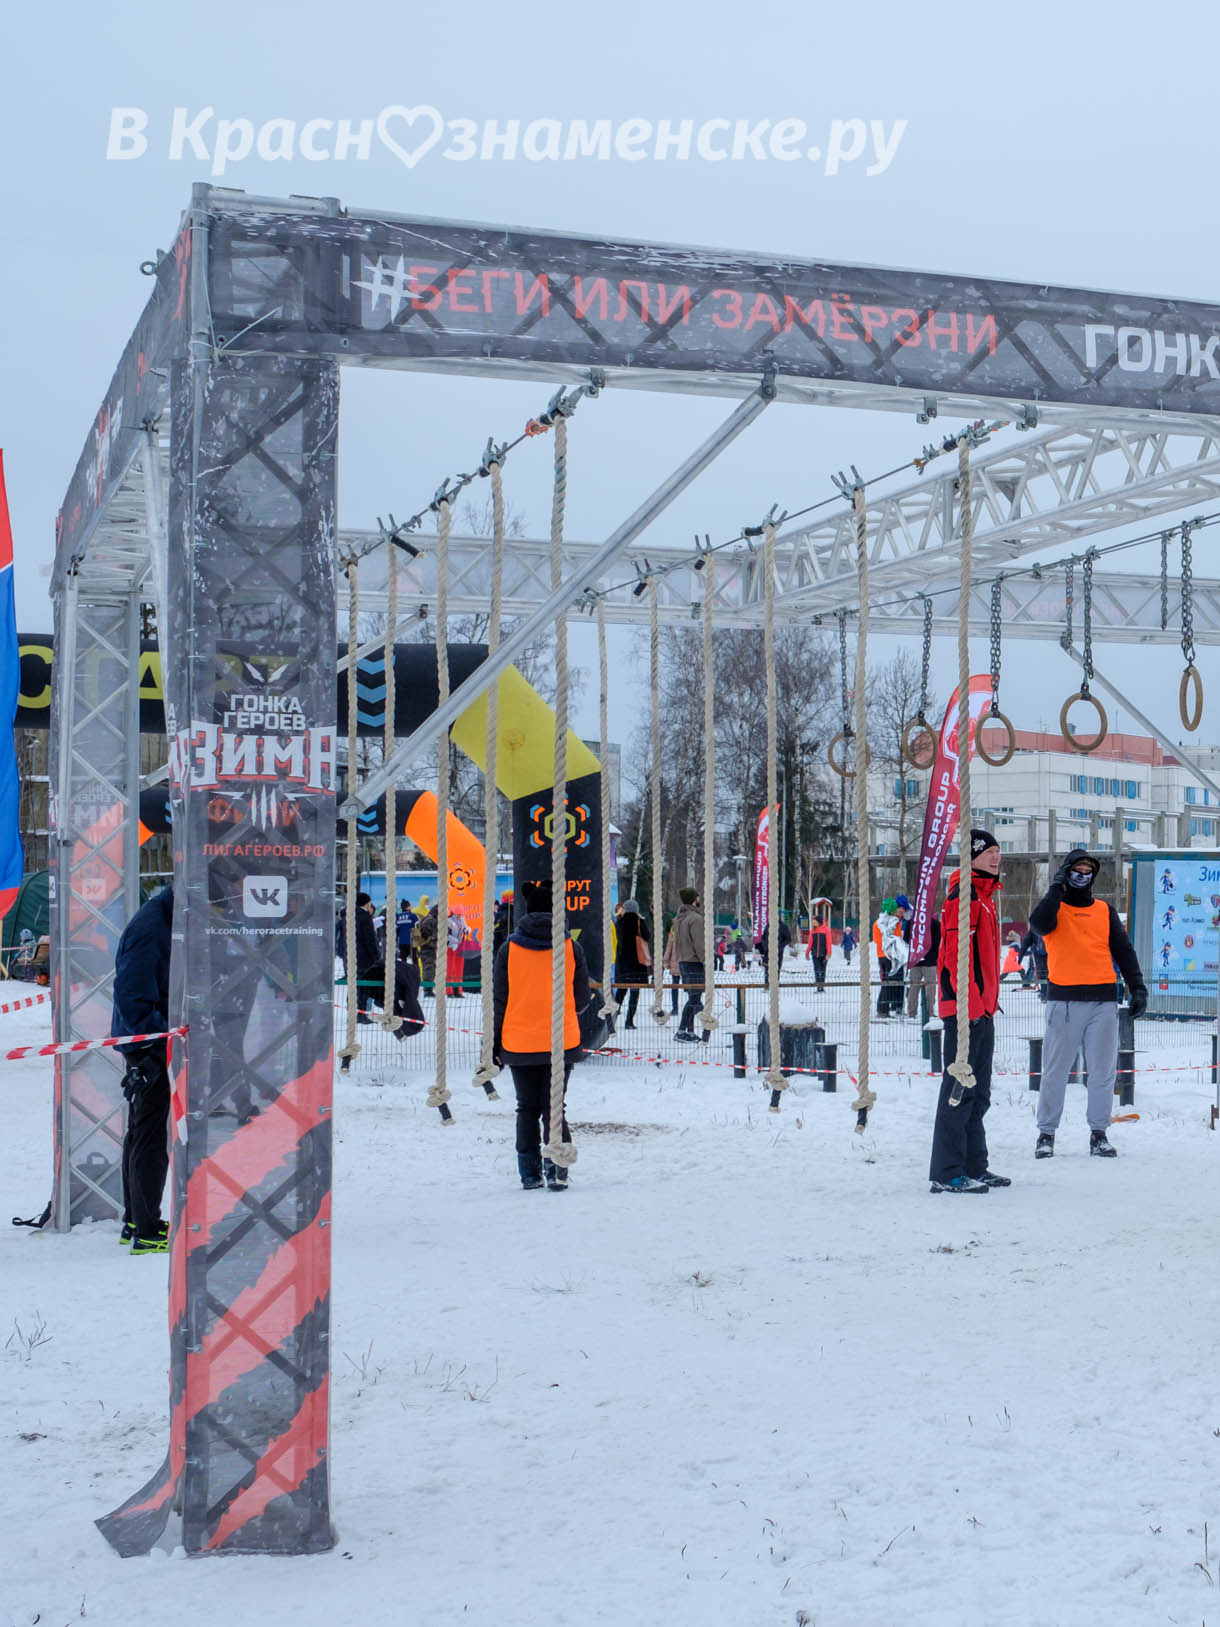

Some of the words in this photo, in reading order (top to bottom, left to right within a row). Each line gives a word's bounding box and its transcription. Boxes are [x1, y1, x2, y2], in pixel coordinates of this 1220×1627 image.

[573, 274, 692, 325] ИЛИ
[711, 283, 998, 356] ЗАМЁРЗНИ
[230, 694, 303, 713] ГОНКА
[223, 711, 306, 730] ГЕРОЕВ
[188, 720, 337, 793] ЗИМА
[204, 926, 324, 937] vk.com/heroracetraining
